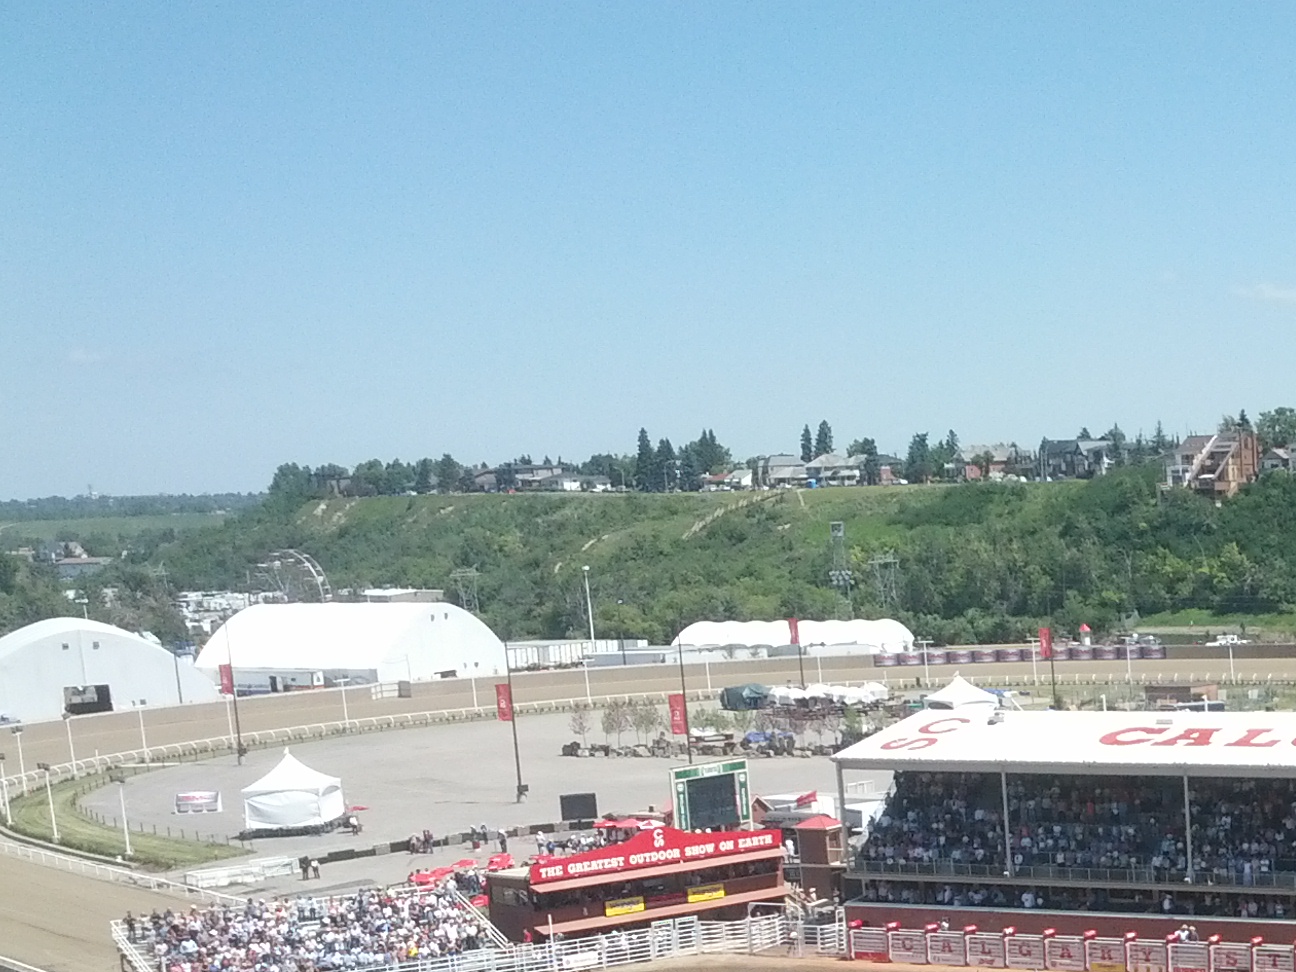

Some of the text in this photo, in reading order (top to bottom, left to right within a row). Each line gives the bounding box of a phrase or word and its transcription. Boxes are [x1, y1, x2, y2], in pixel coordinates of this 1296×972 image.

[539, 833, 773, 879] THE GREATEST OUTDOOR SHOW ON EARTH
